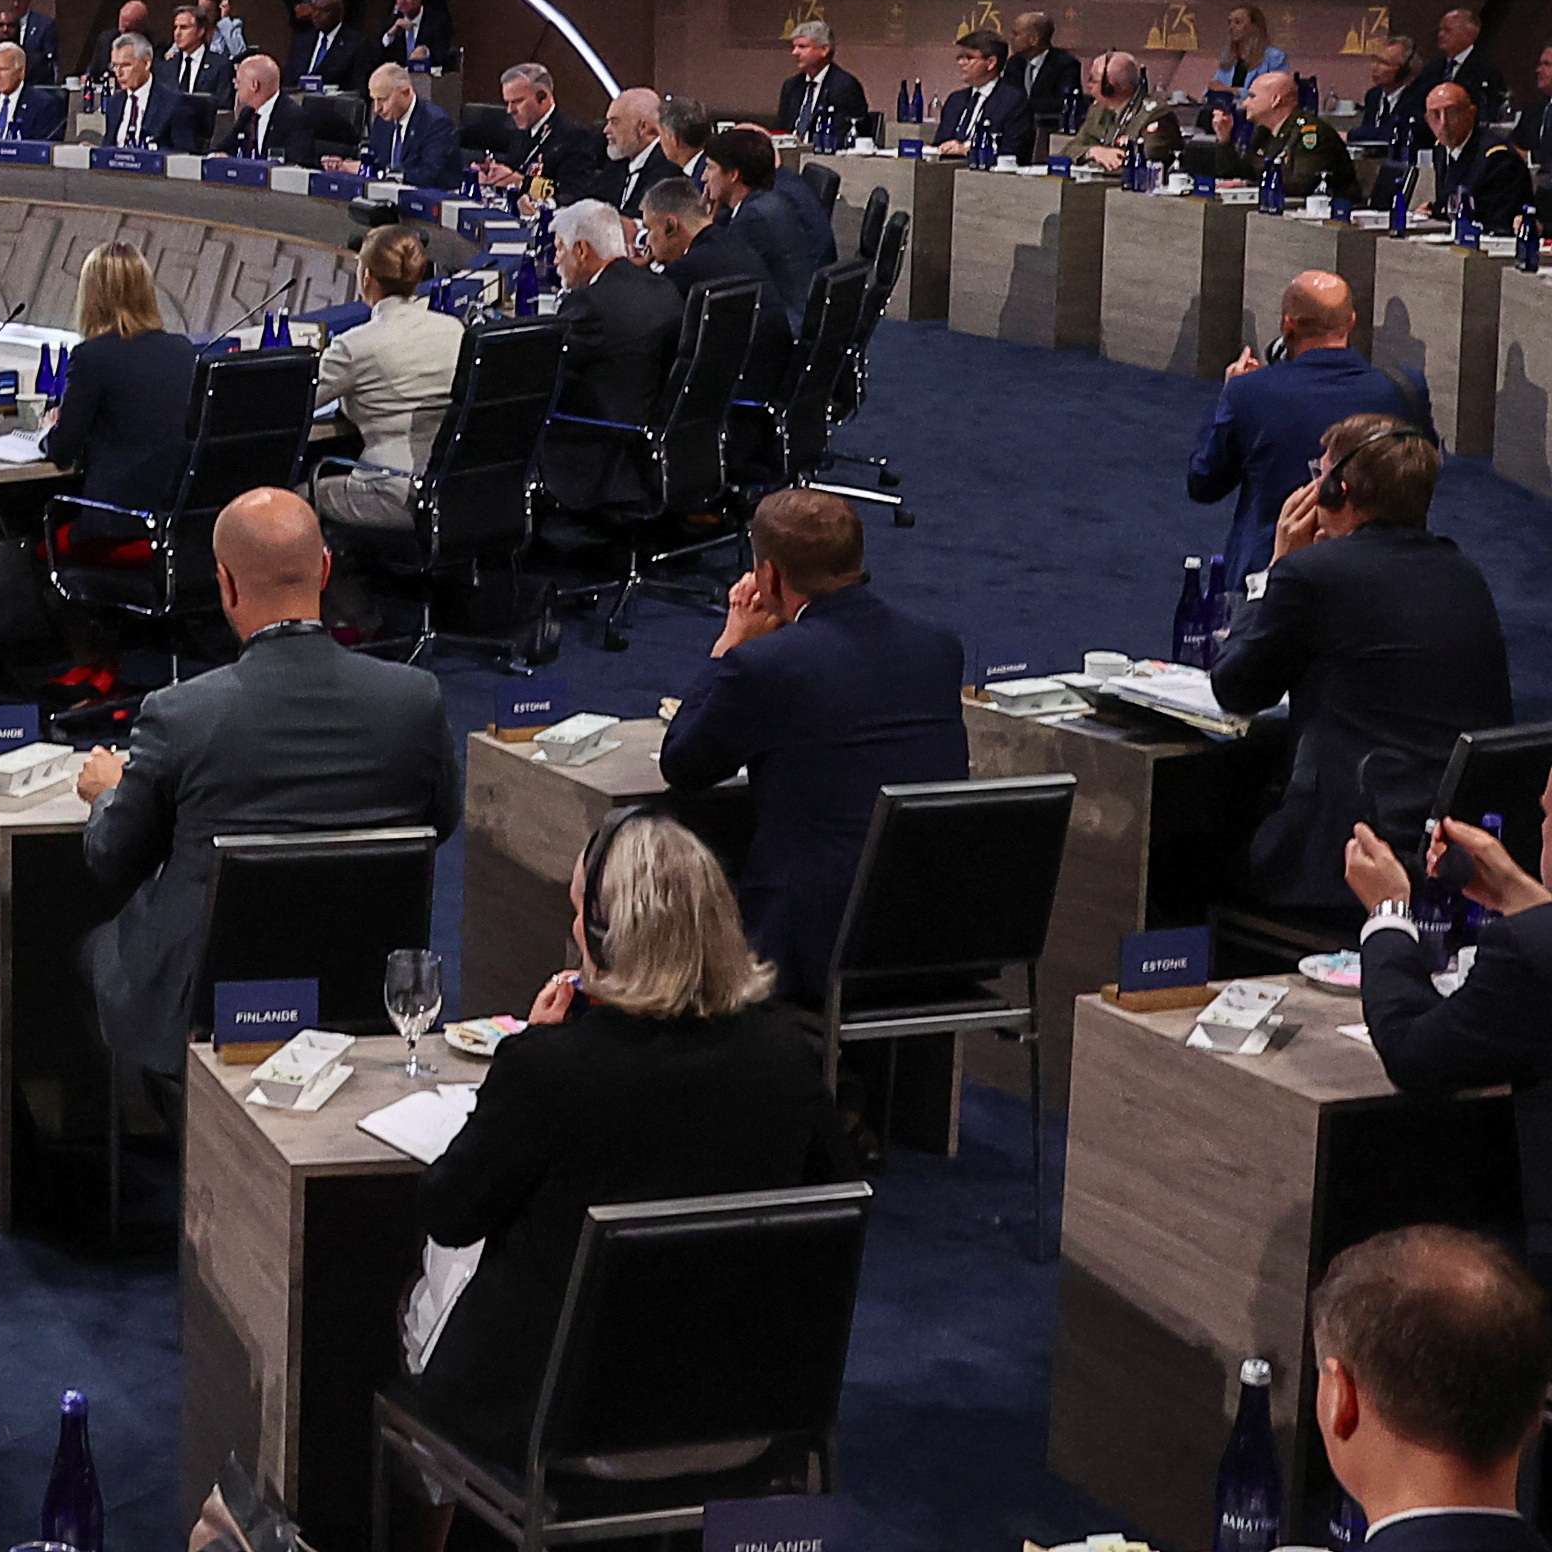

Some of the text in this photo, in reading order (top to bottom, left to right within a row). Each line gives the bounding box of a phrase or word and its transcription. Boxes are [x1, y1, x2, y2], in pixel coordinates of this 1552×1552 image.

[977, 1, 1002, 34] 75
[1169, 4, 1196, 36] 75
[1141, 957, 1188, 974] ESTONIE
[235, 1009, 299, 1024] FINLANDE
